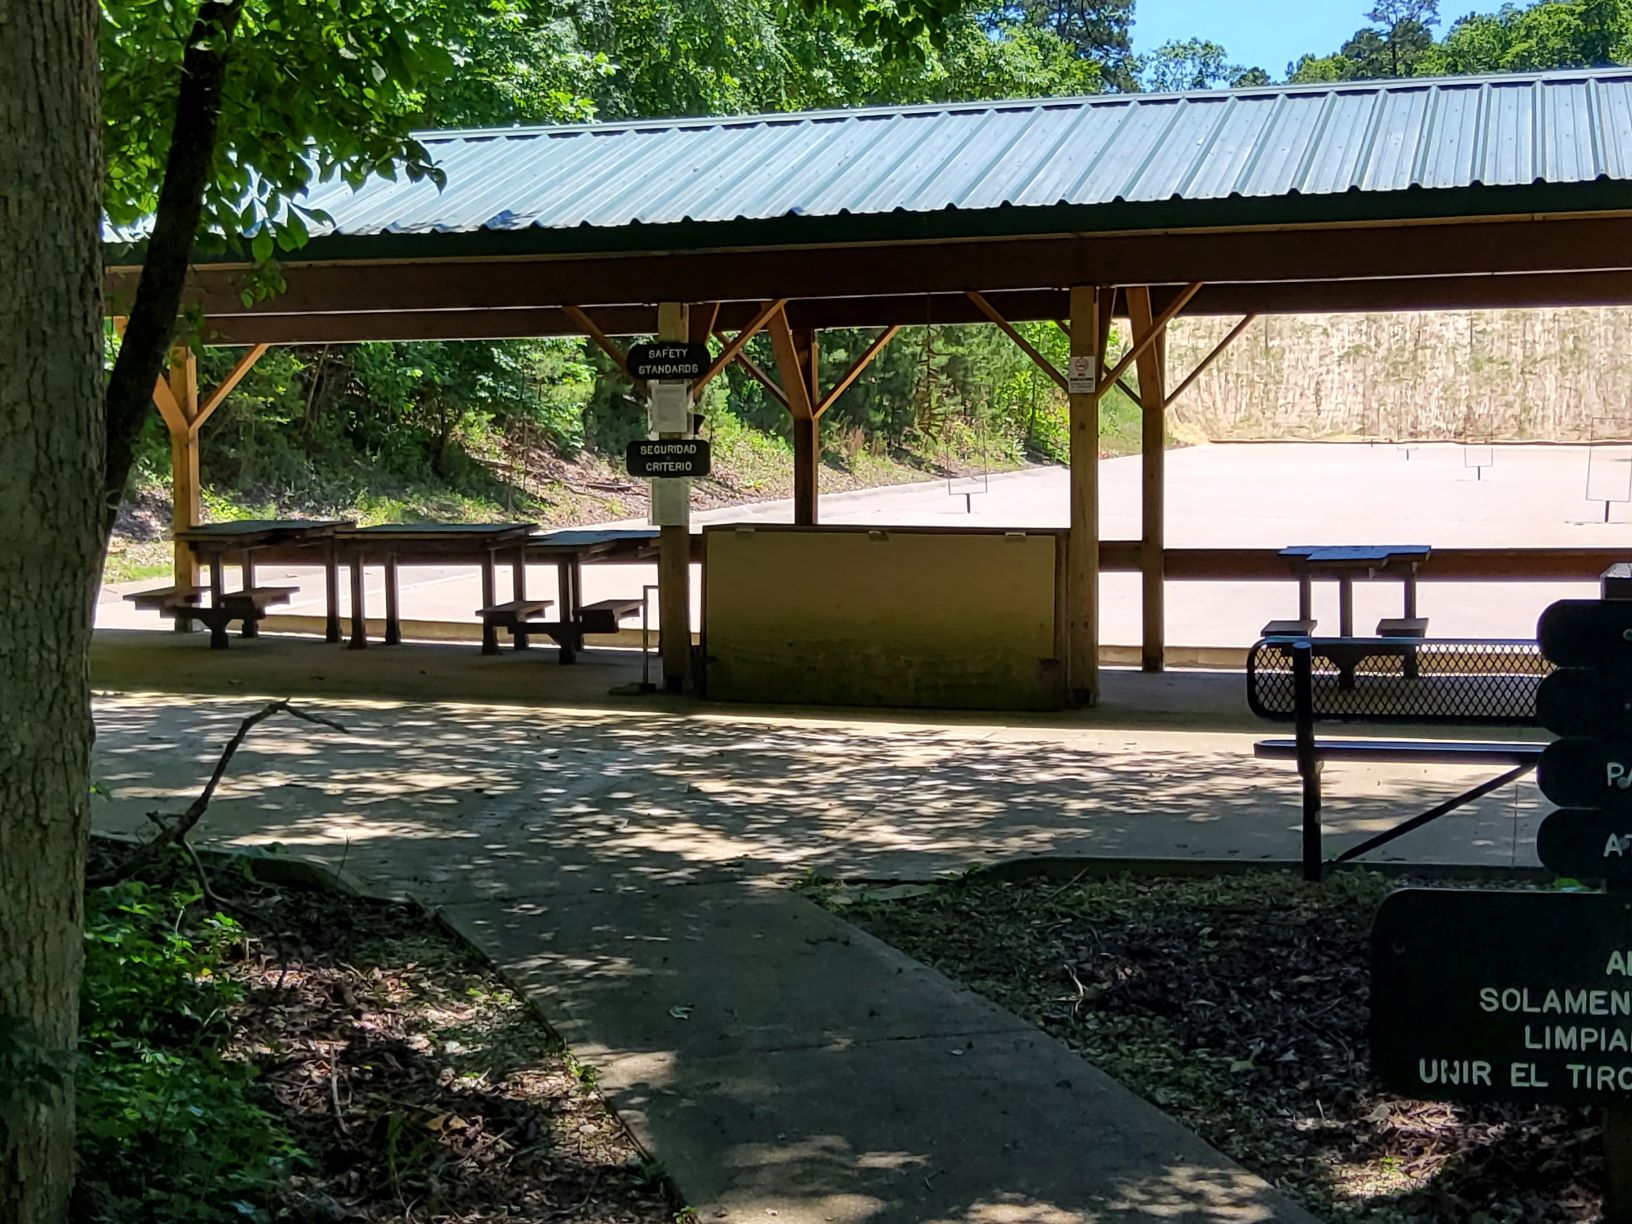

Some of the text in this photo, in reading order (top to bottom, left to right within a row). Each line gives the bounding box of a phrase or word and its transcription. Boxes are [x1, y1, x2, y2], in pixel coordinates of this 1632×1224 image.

[648, 348, 688, 359] SAFETY
[638, 363, 699, 375] STANDARDS
[640, 444, 697, 455] SEGURIDAD
[645, 461, 693, 472] CRITERIO
[1479, 986, 1632, 1016] SOLAMEN
[1523, 1024, 1632, 1052] LIMPIA
[1418, 1057, 1493, 1087] UNIR
[1510, 1061, 1550, 1087] EL
